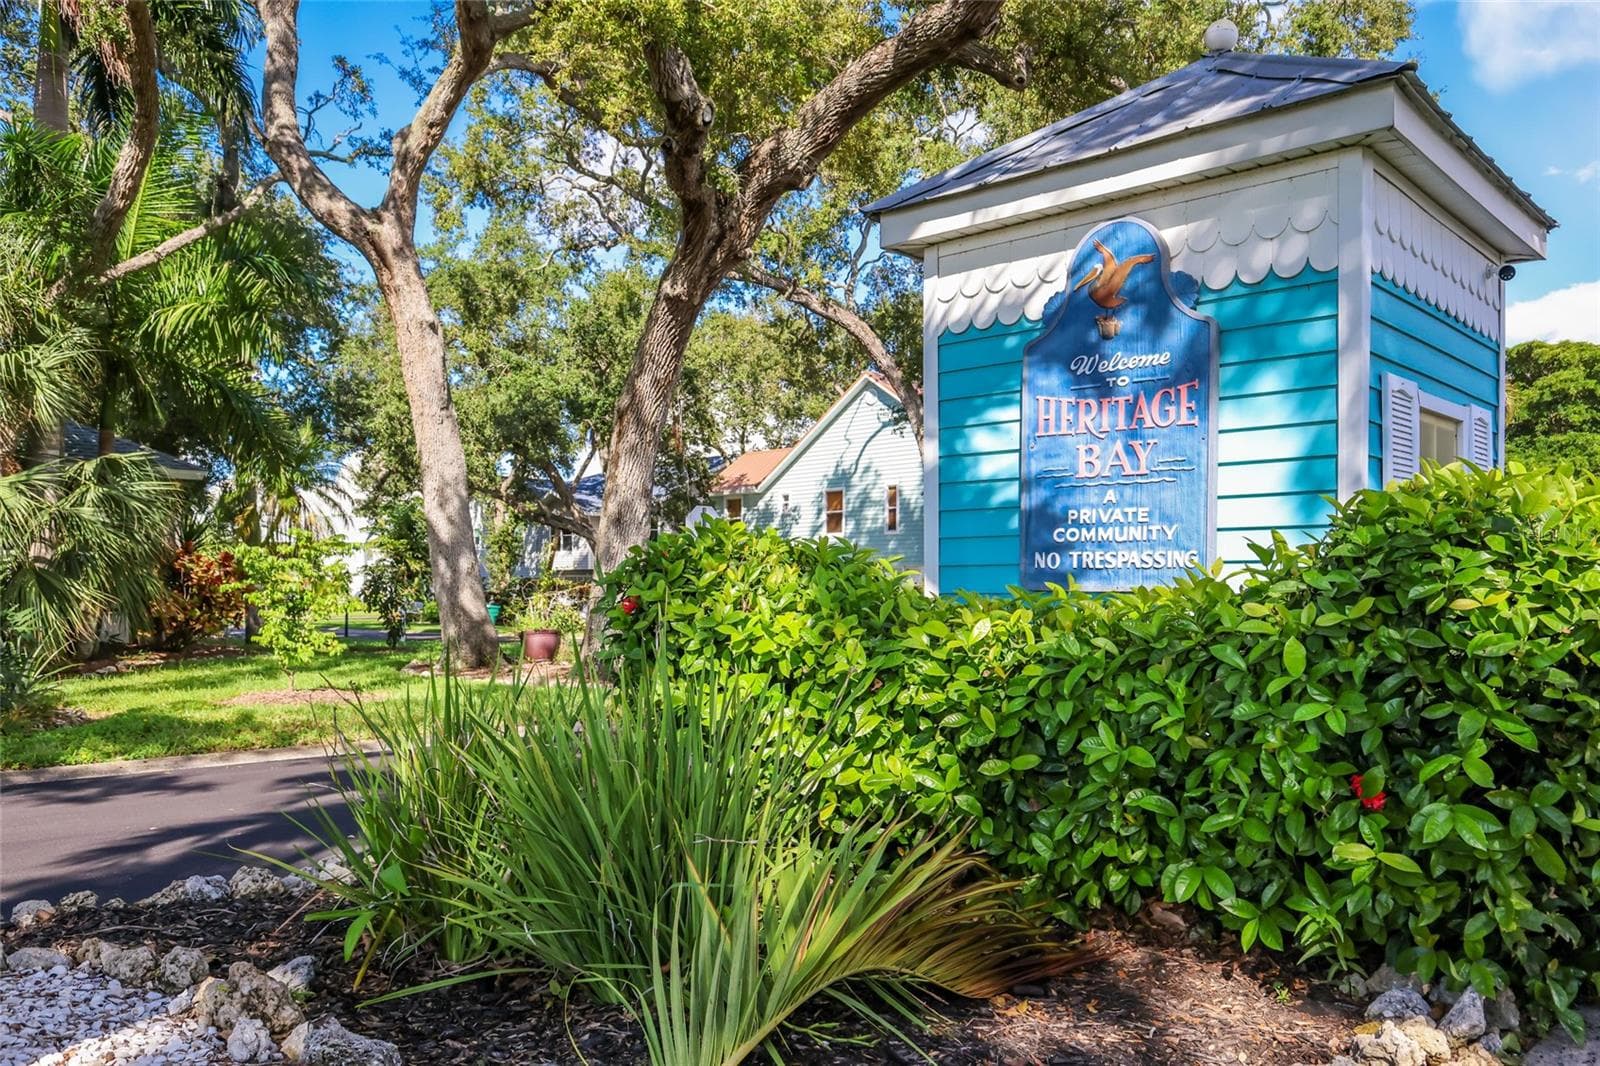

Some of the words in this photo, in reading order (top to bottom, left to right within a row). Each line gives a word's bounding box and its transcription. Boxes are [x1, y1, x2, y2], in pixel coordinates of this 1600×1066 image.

[1070, 351, 1171, 375] Welcome
[1105, 376, 1130, 387] TO
[1035, 379, 1200, 439] HERITAGE
[1075, 439, 1158, 478] BAY
[1102, 489, 1117, 504] A
[1067, 507, 1150, 524] PRIVATE
[1052, 524, 1178, 542] COMMUNITY
[1034, 551, 1061, 569] NO
[1069, 550, 1199, 569] TRESPASSING
